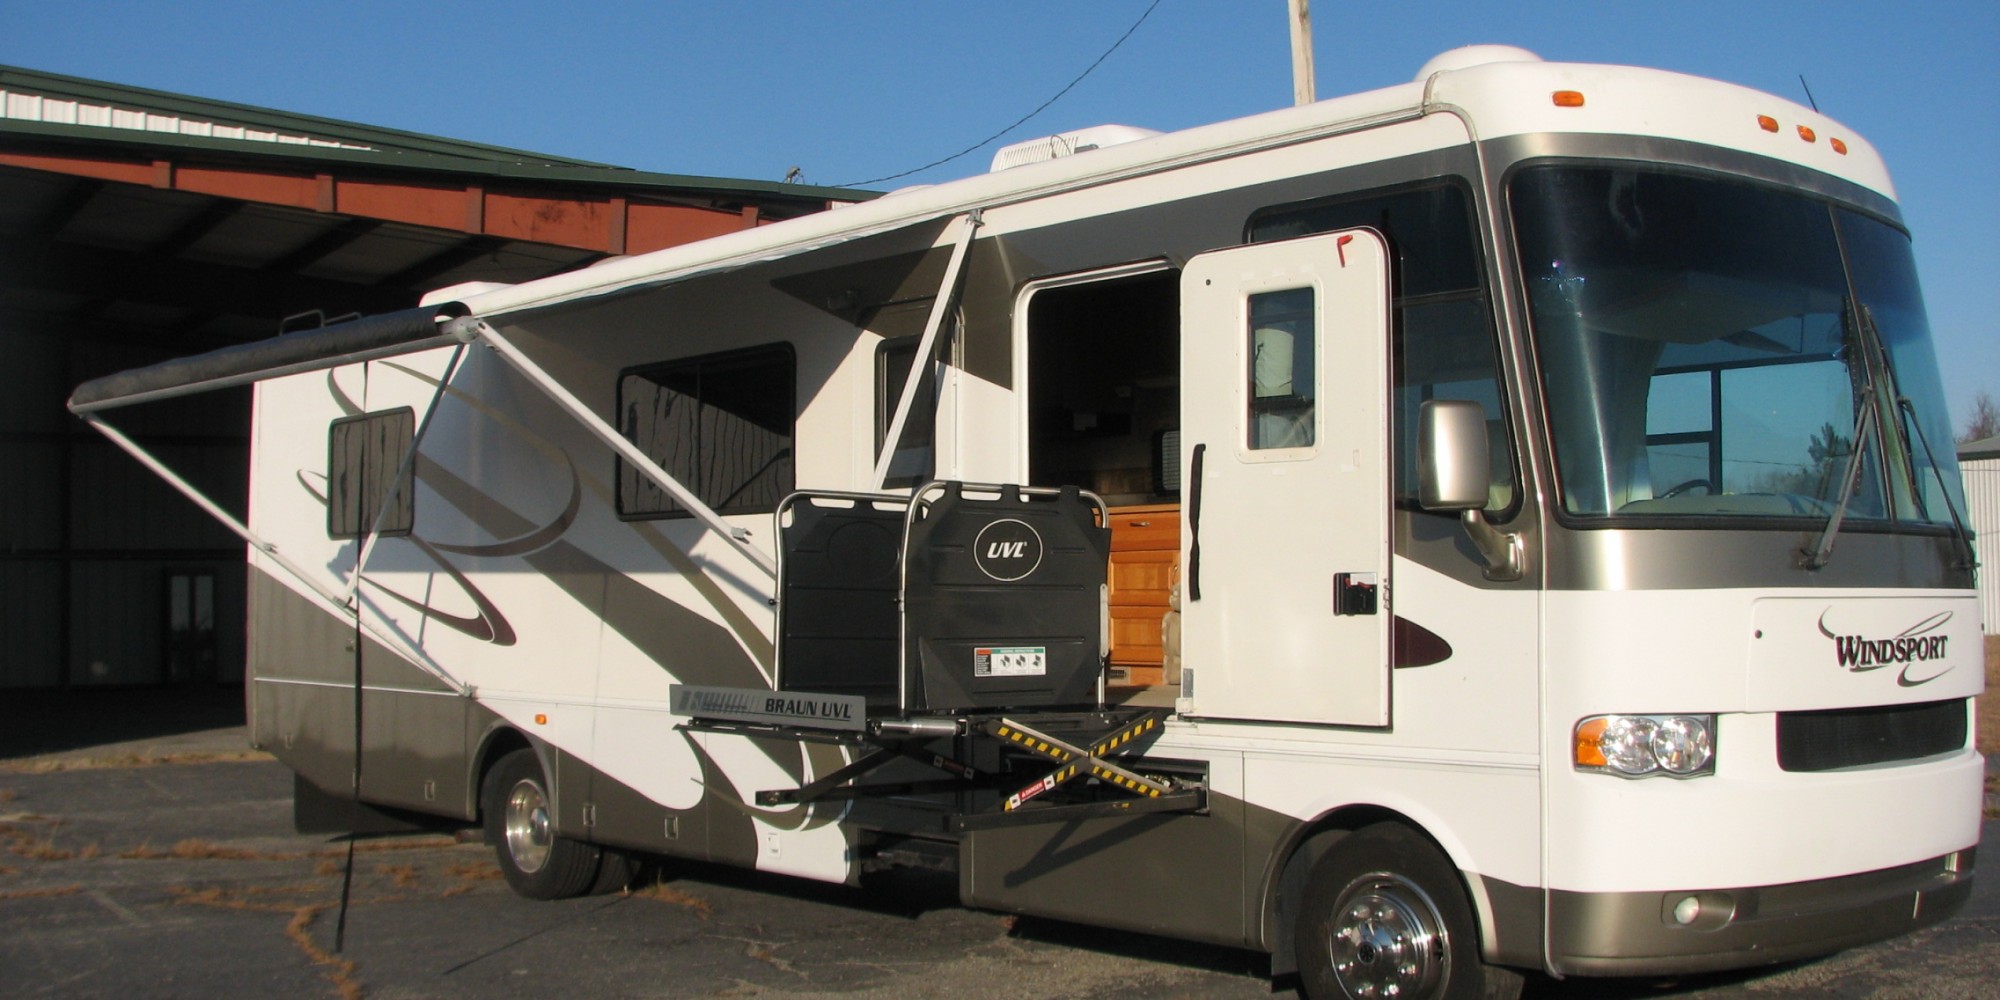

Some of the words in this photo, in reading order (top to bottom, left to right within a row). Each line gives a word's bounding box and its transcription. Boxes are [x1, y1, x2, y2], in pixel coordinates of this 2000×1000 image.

[987, 542, 1024, 558] UVL
[1835, 635, 1948, 667] WINDSPORT
[765, 698, 818, 716] BRAUN
[821, 701, 851, 719] UVL
